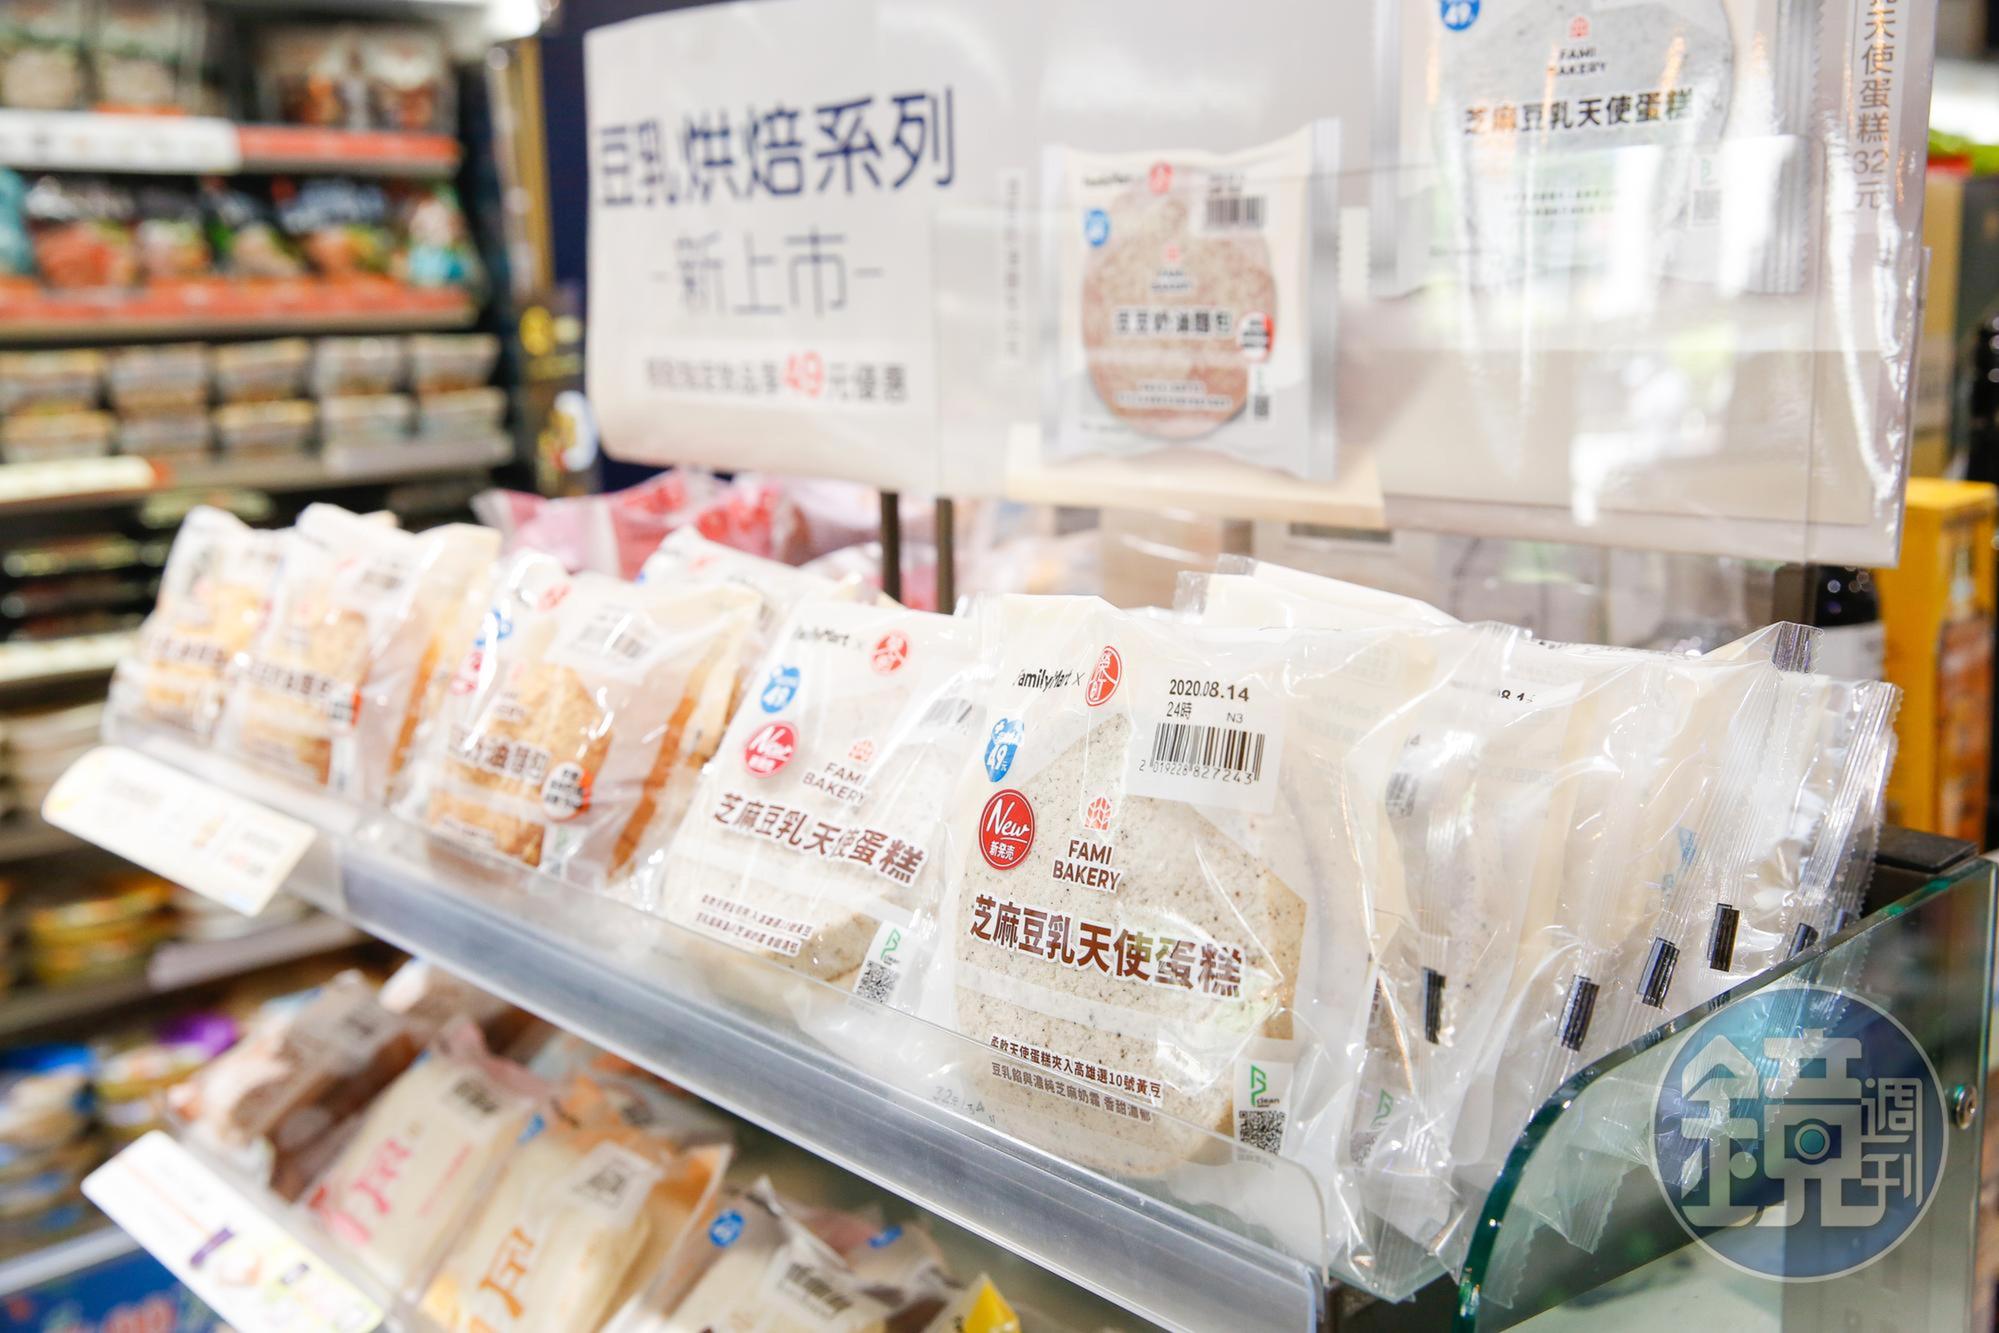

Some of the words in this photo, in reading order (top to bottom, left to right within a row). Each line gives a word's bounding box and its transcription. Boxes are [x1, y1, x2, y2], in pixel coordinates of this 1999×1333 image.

[1464, 87, 1693, 134] 芝麻豆乳天使蛋糕
[597, 84, 957, 207] 豆乳烘焙系列
[1168, 678, 1250, 702] 2020.08.14
[1166, 701, 1193, 720] 24時
[1226, 711, 1244, 724] N3
[985, 798, 1031, 838] New
[712, 792, 925, 884] 芝麻豆乳天使蛋糕
[1068, 839, 1113, 866] FAMI
[1052, 860, 1122, 891] BAKERY
[970, 893, 1244, 998] 芝麻豆乳天使蛋糕
